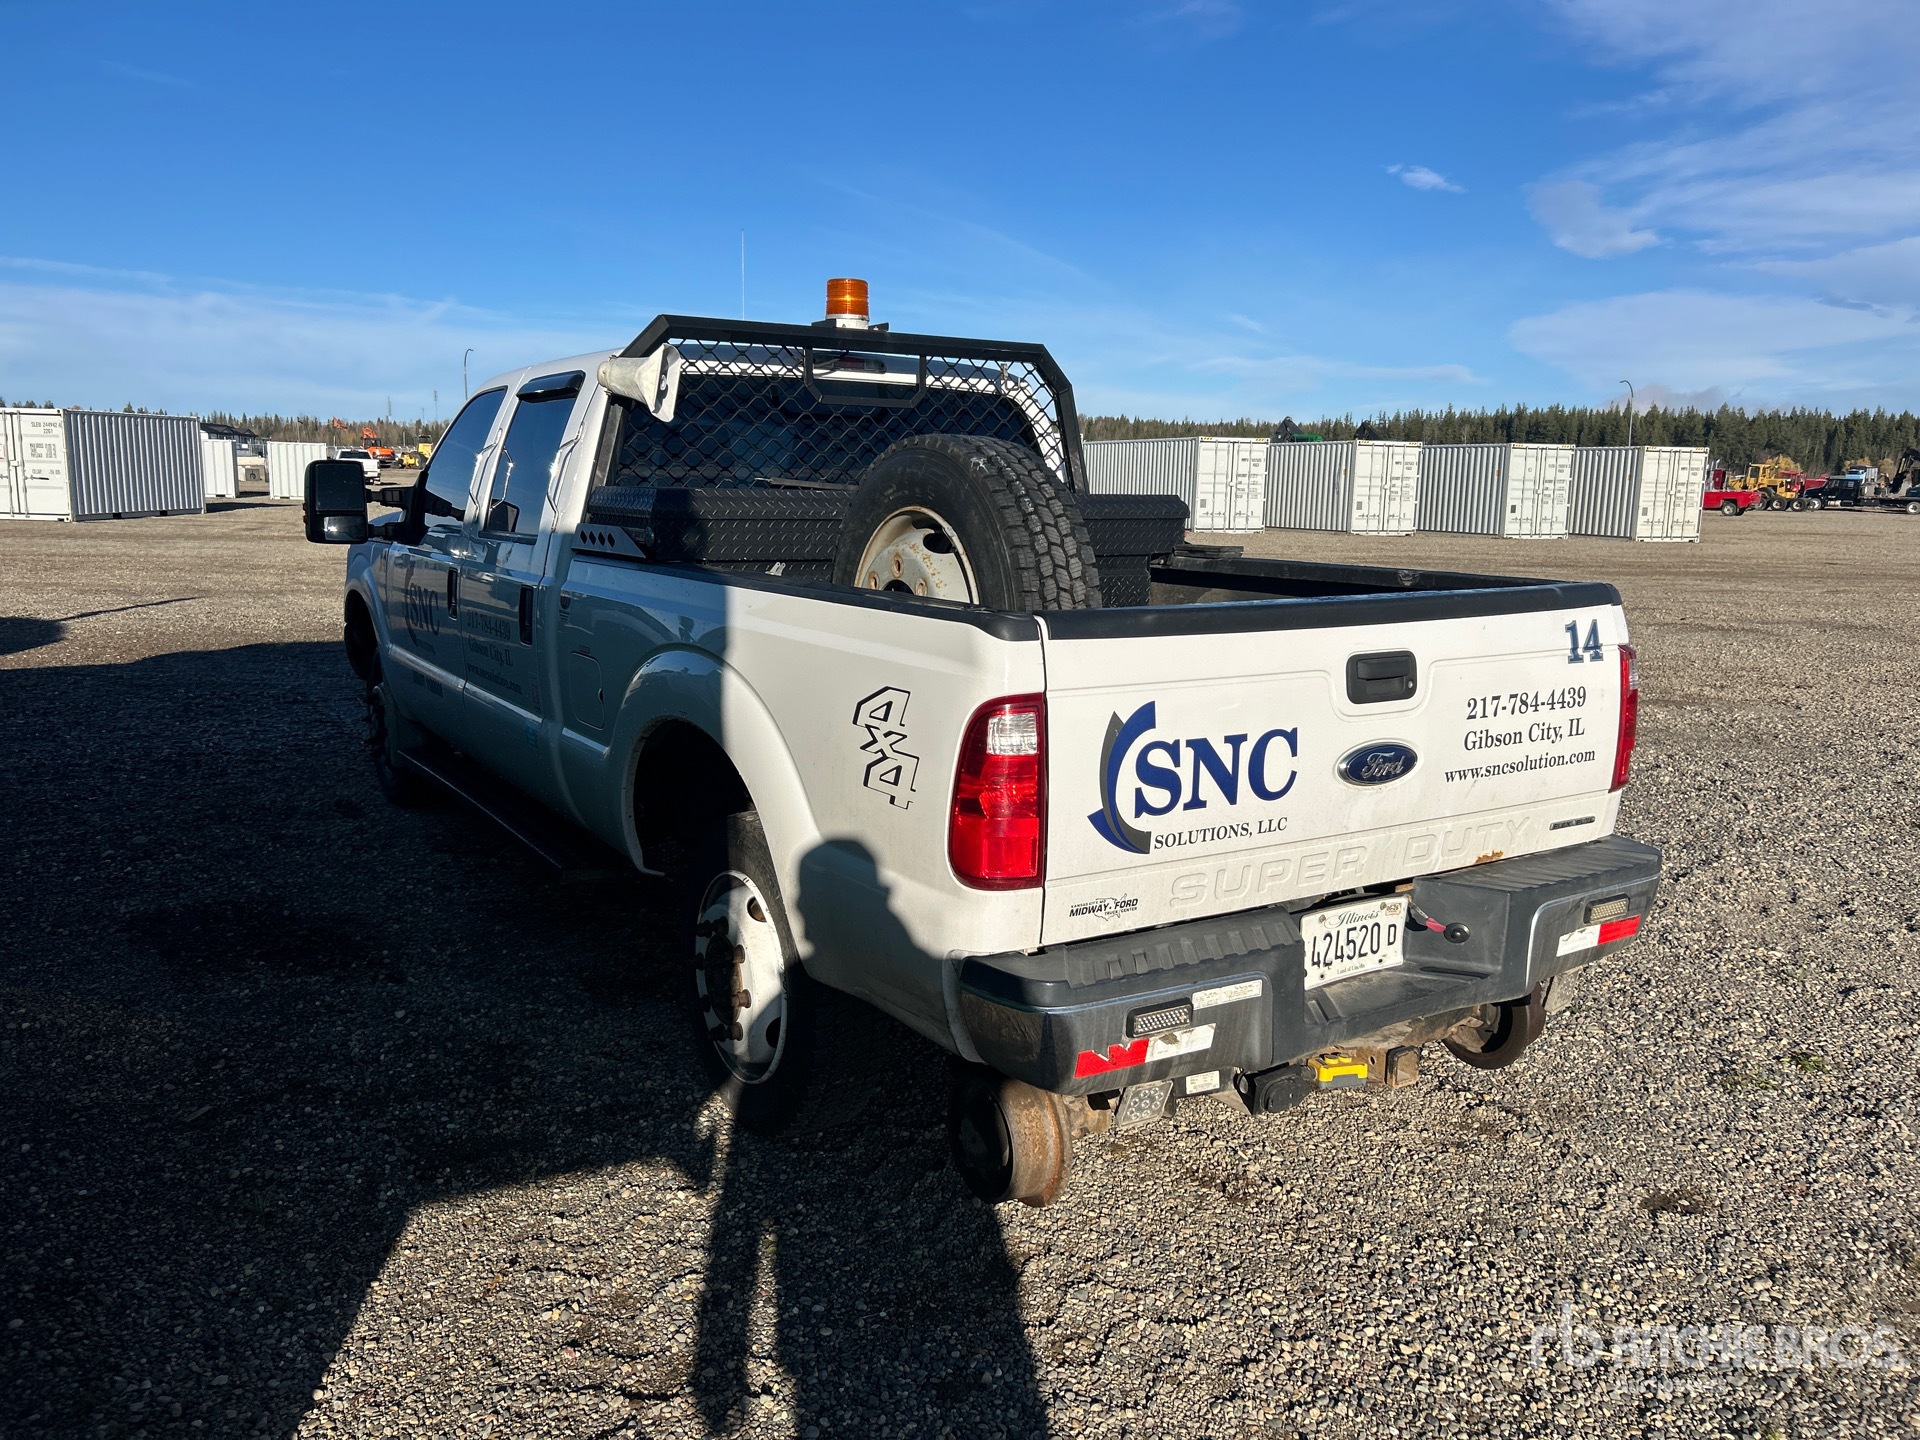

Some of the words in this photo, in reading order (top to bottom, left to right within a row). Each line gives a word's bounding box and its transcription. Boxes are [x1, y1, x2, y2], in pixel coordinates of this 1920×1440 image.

[409, 582, 440, 636] SNC
[1565, 619, 1604, 664] 14
[1466, 686, 1587, 720] 217-784-4439
[1464, 727, 1523, 751] Gibson
[1528, 721, 1563, 744] City,
[1567, 718, 1586, 737] IL
[1134, 727, 1298, 819] SNC
[1360, 751, 1404, 779] Ford
[1444, 749, 1596, 783] www.sncsolution.com
[1153, 822, 1253, 850] SOLUTIONS,
[1257, 816, 1288, 834] LLC
[1169, 845, 1368, 908] SUPER
[1402, 816, 1530, 867] DUTY
[1069, 902, 1110, 918] MIDWAY
[1114, 898, 1138, 910] FORD
[1323, 910, 1380, 930] Illinois
[1311, 921, 1381, 969] 424520
[1387, 923, 1397, 946] D
